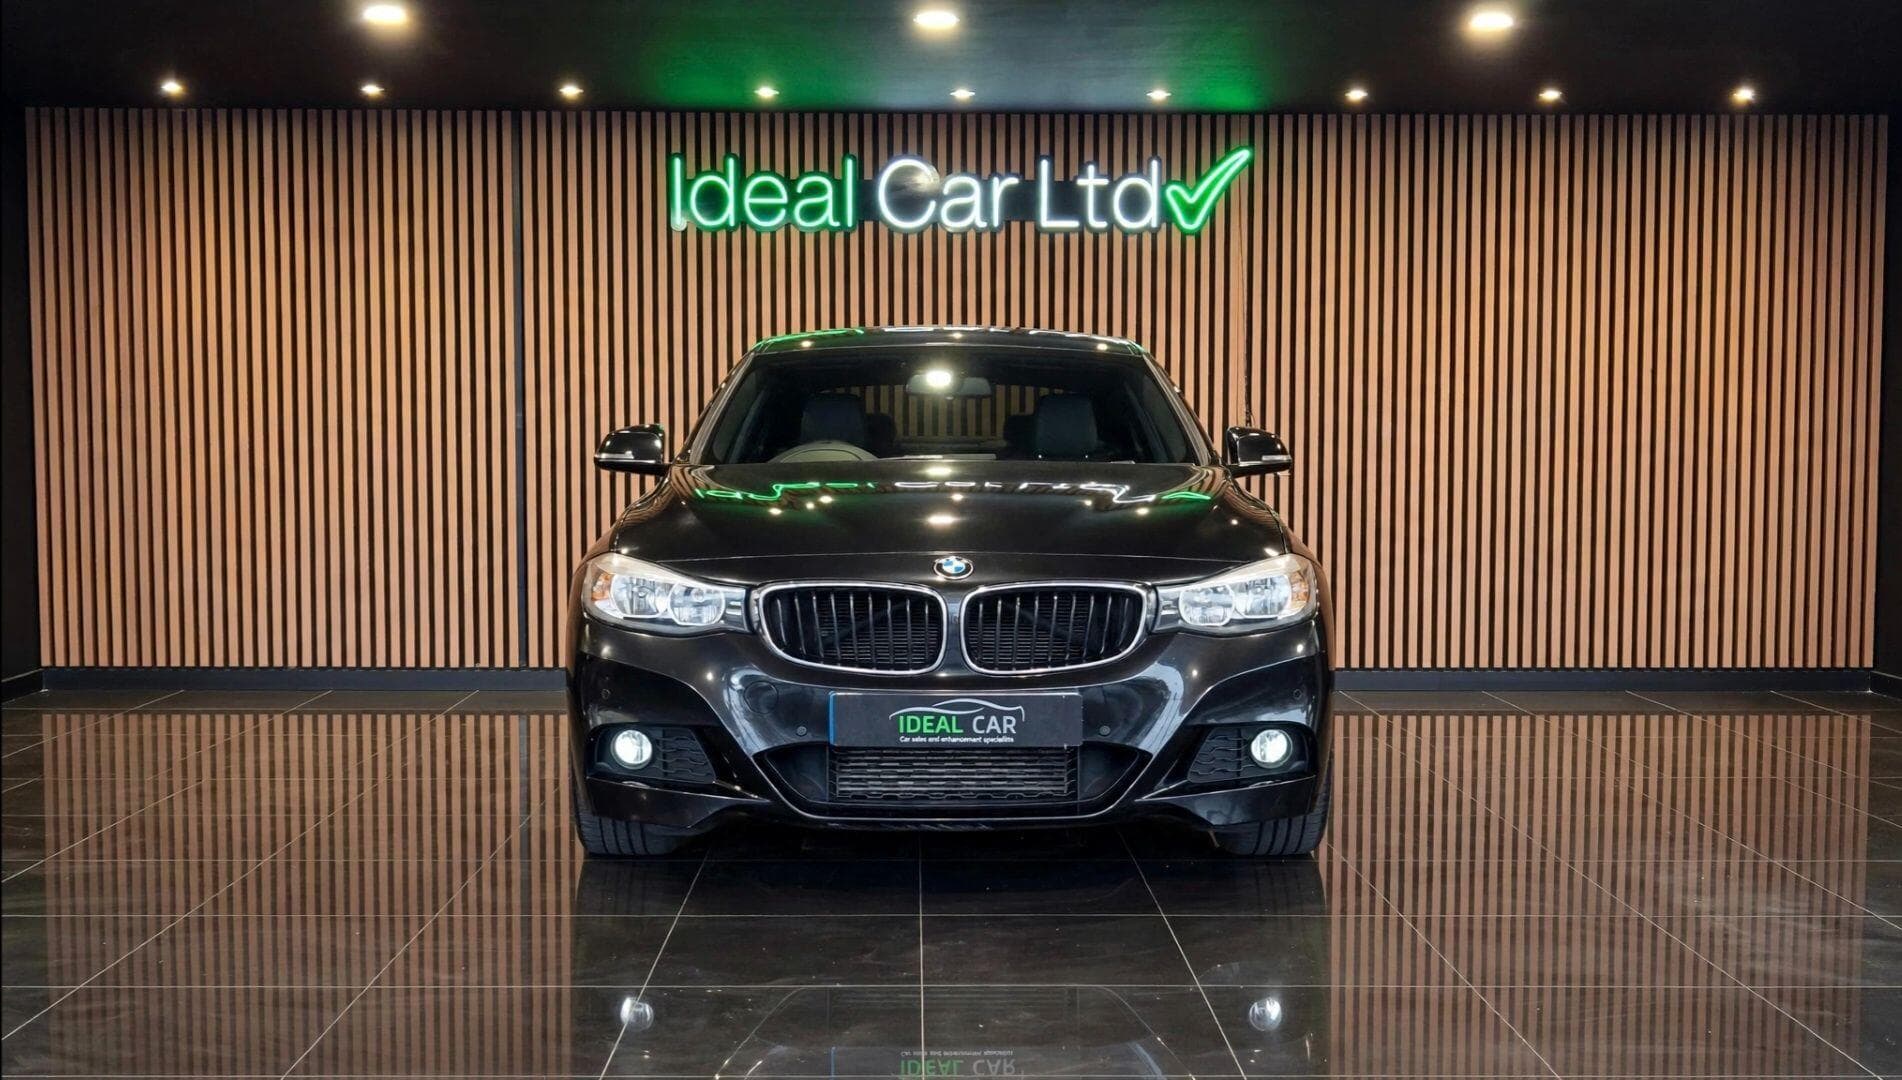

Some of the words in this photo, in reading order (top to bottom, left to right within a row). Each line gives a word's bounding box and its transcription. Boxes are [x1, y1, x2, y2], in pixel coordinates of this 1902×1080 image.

[671, 155, 853, 229] Ideal
[877, 157, 1019, 229] Car
[1039, 157, 1160, 229] Ltd
[899, 715, 964, 734] IDEAL
[972, 715, 1017, 734] CAR
